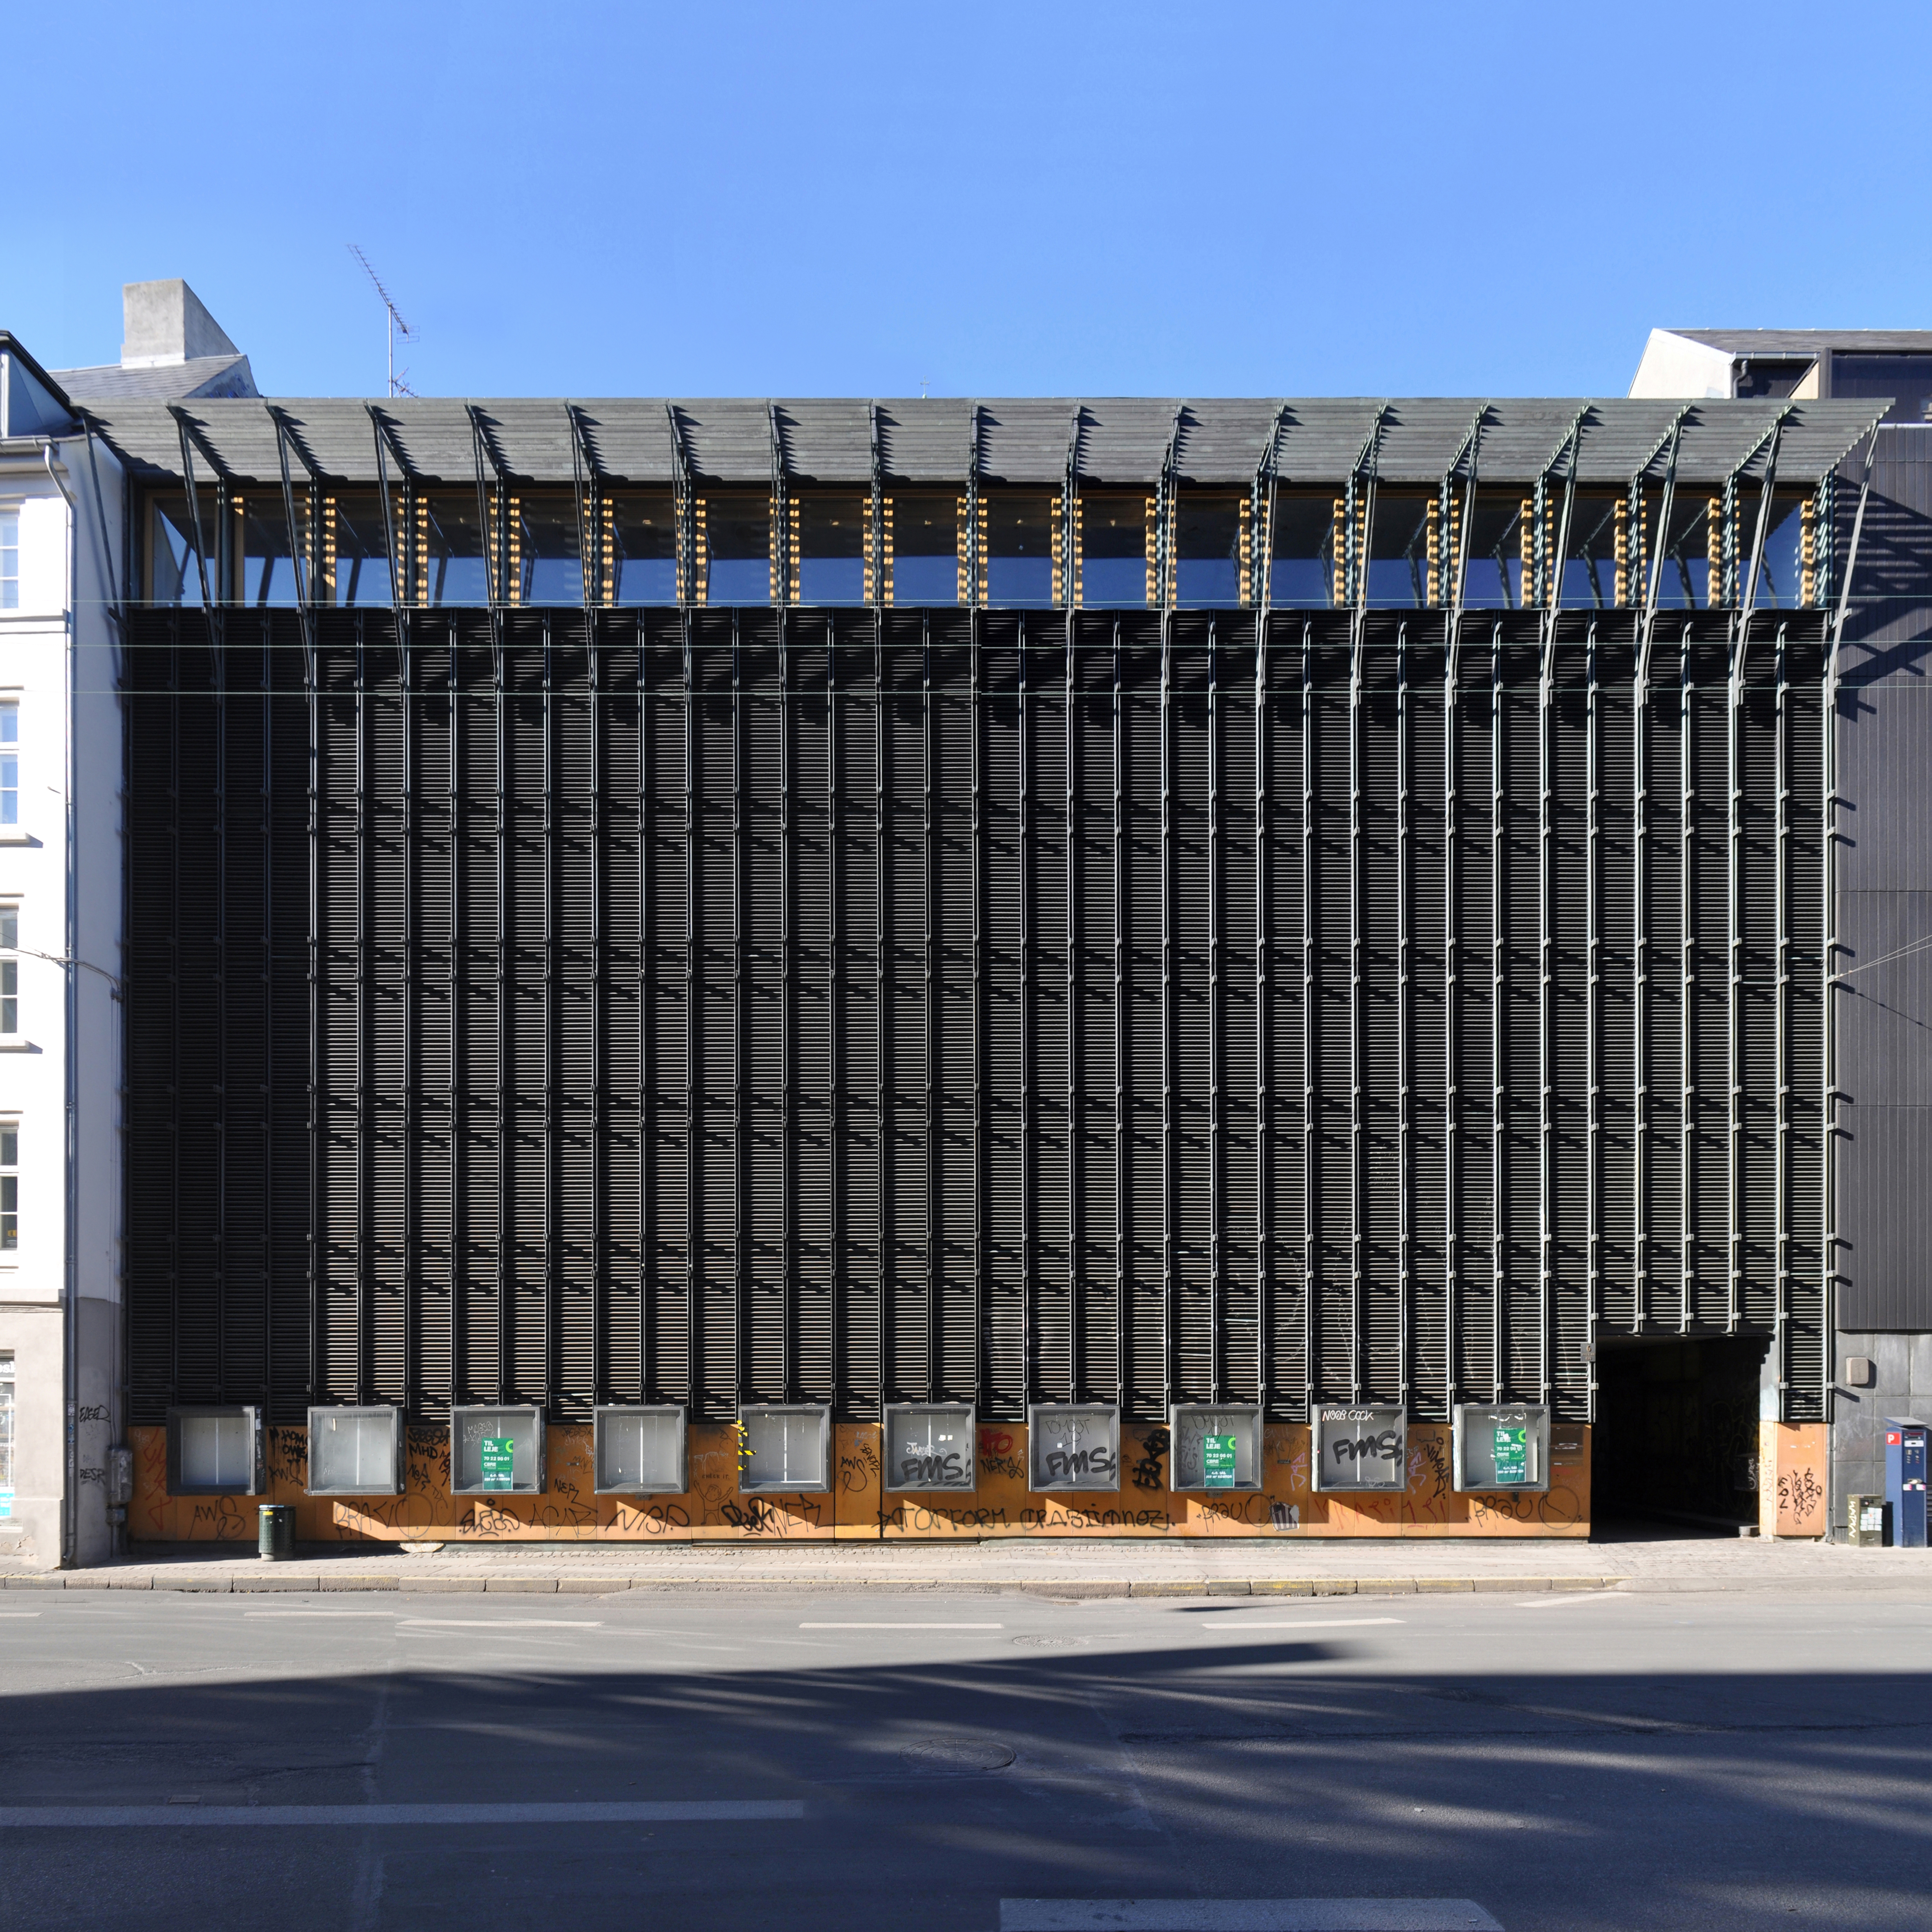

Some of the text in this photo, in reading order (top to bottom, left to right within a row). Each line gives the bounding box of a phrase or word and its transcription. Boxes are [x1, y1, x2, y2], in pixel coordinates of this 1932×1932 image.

[409, 1442, 438, 1459] MHD
[1333, 1430, 1400, 1464] FMS
[1887, 1434, 1895, 1444] P
[901, 1453, 964, 1482] FMS
[1046, 1447, 1111, 1476] FMS
[528, 1503, 597, 1538] ACAB
